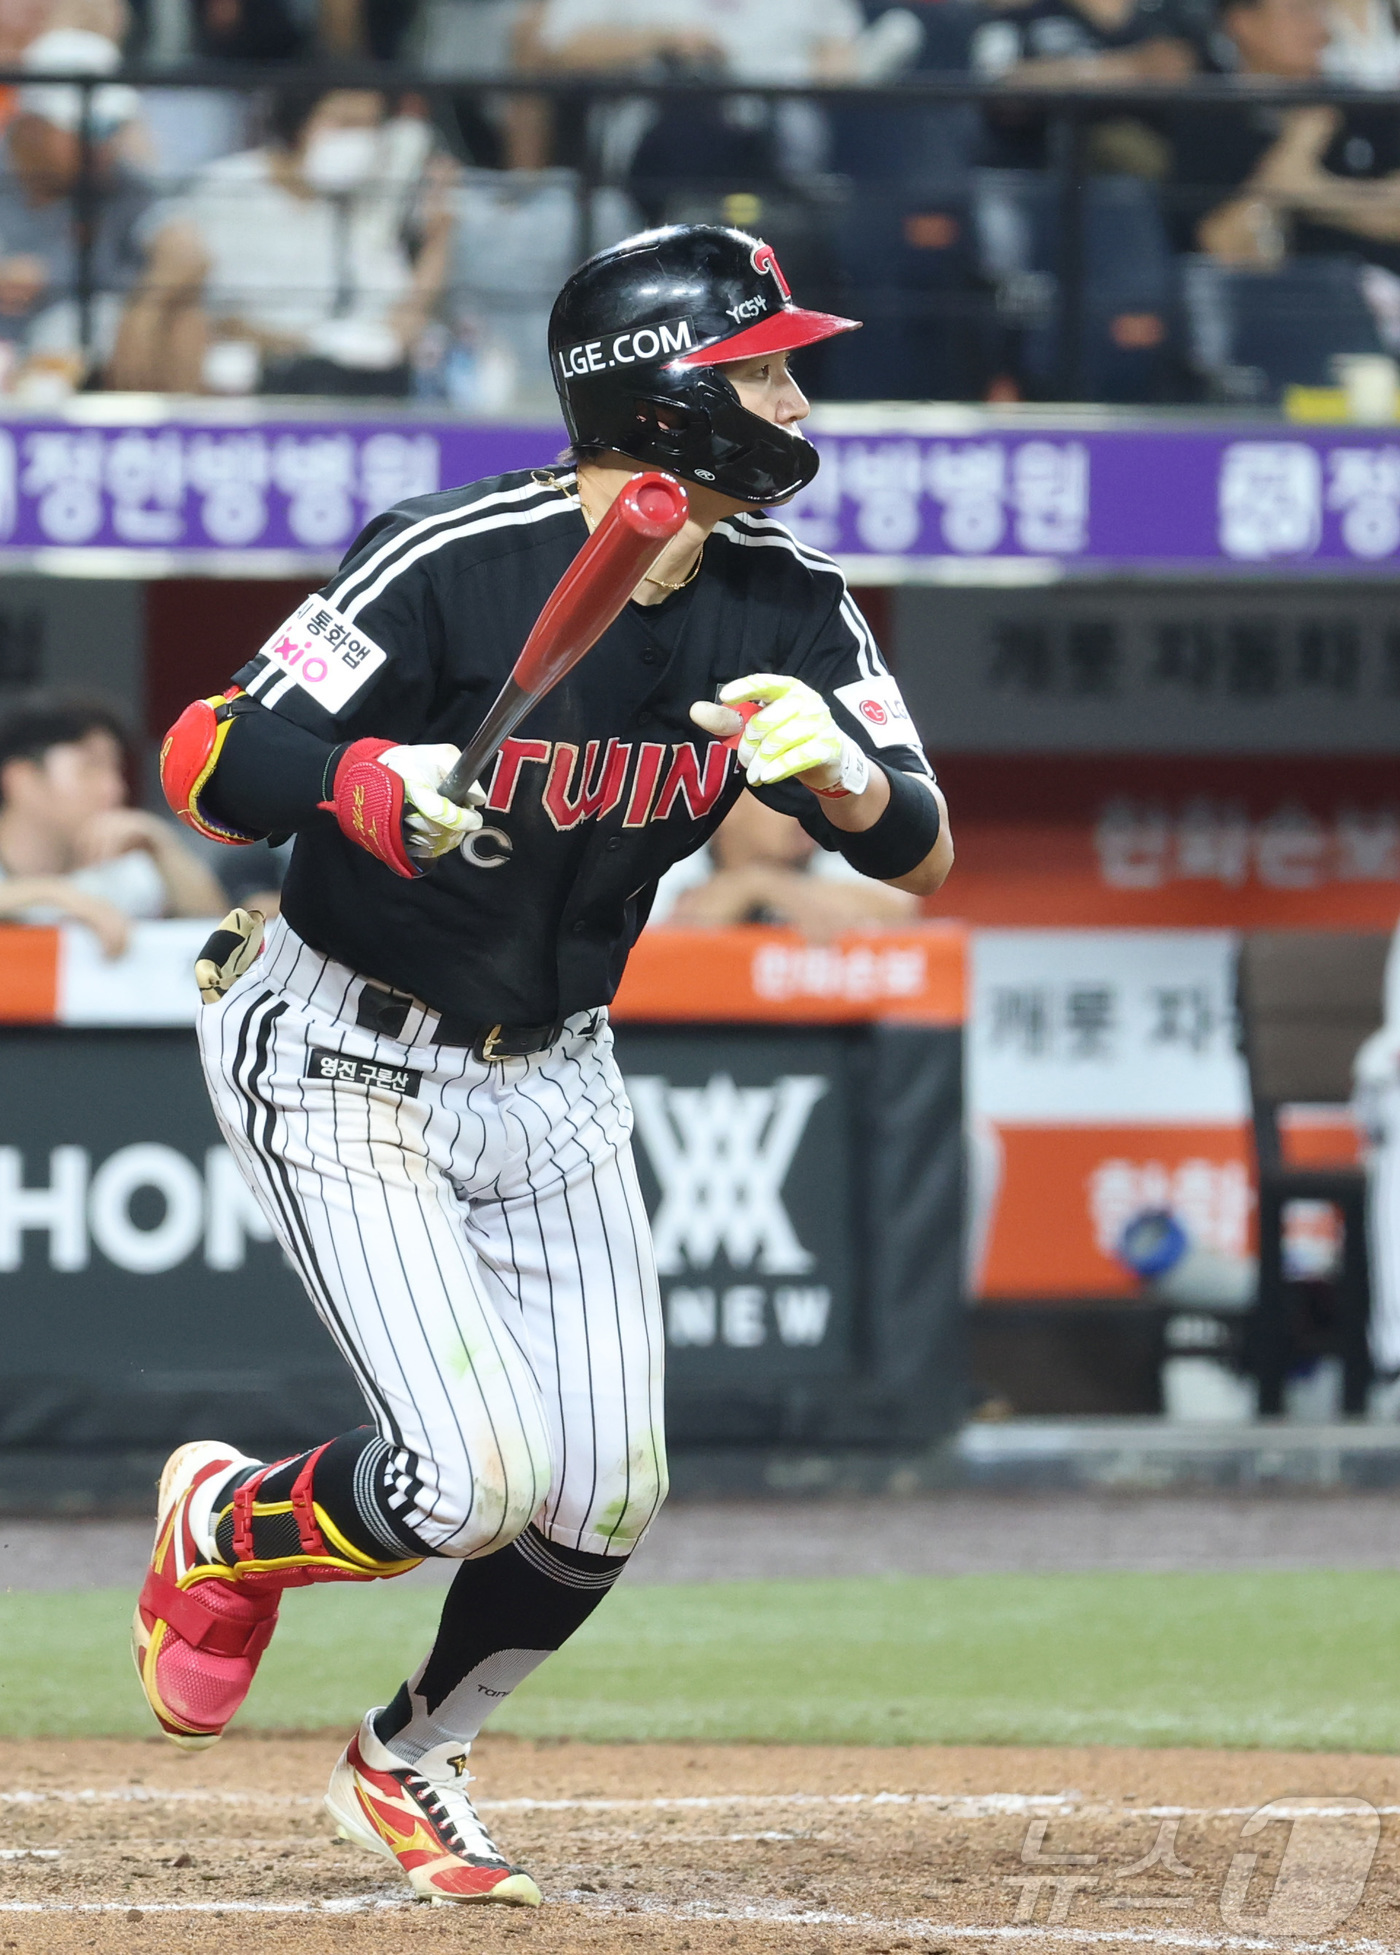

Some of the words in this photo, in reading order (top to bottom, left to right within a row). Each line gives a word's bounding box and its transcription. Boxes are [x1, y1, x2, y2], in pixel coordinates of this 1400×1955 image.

[725, 294, 768, 325] YC54
[559, 320, 693, 379] LGE.COM
[306, 609, 371, 670] 통화앱
[485, 736, 742, 831] TWIN
[460, 826, 513, 868] C
[320, 1057, 357, 1081] 영진
[360, 1064, 409, 1092] 구론산
